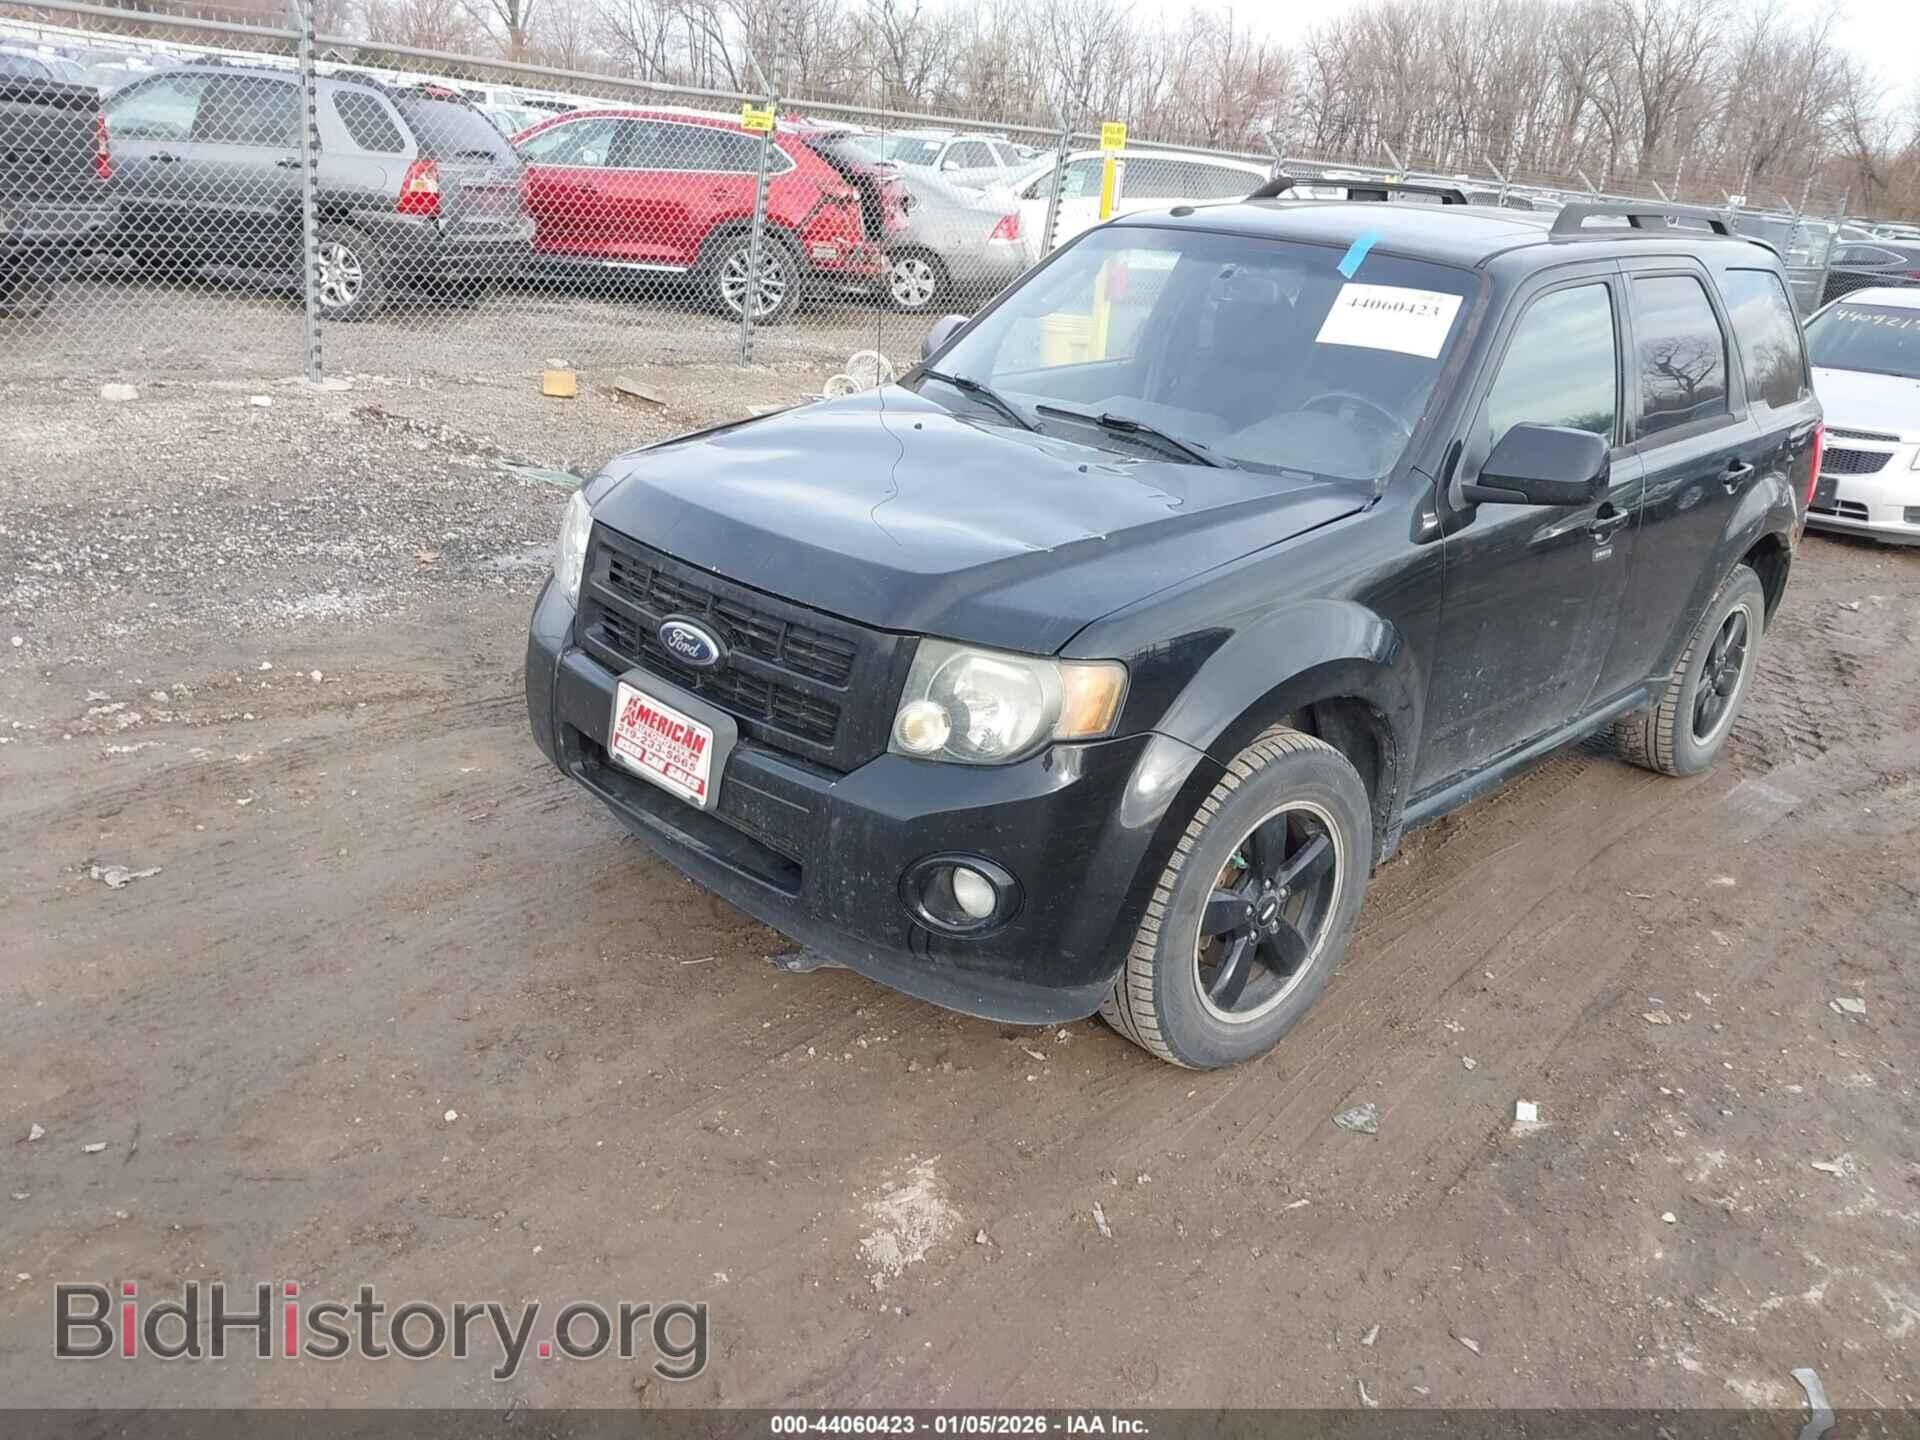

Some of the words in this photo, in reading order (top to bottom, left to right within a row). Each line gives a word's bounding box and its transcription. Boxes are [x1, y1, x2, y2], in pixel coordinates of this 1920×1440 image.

[1347, 297, 1440, 317] 44060423
[668, 628, 701, 657] Ford
[621, 696, 706, 754] AMERICAN
